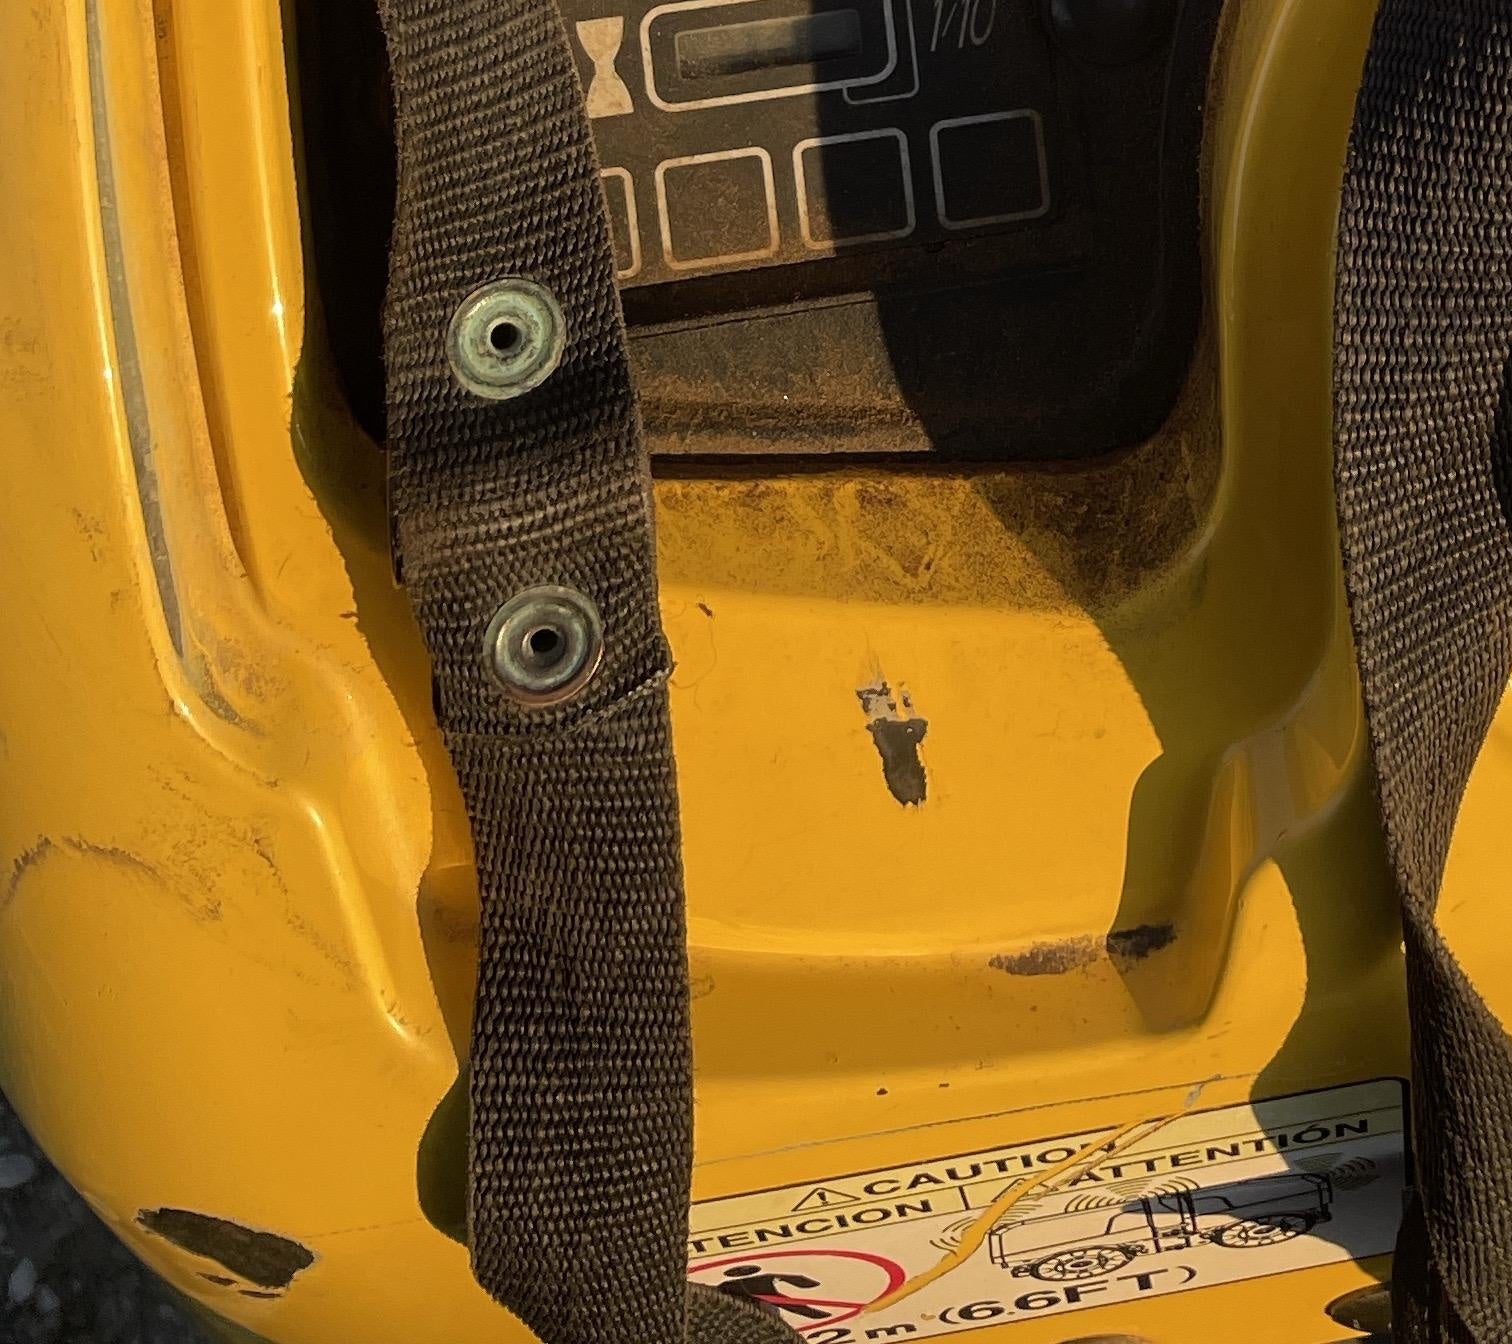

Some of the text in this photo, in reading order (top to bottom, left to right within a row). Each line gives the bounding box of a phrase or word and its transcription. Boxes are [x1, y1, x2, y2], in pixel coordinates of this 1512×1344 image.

[863, 1139, 1117, 1196] CAUTION
[690, 1200, 933, 1253] TENCION
[938, 1264, 1198, 1327] (6.6FT)
